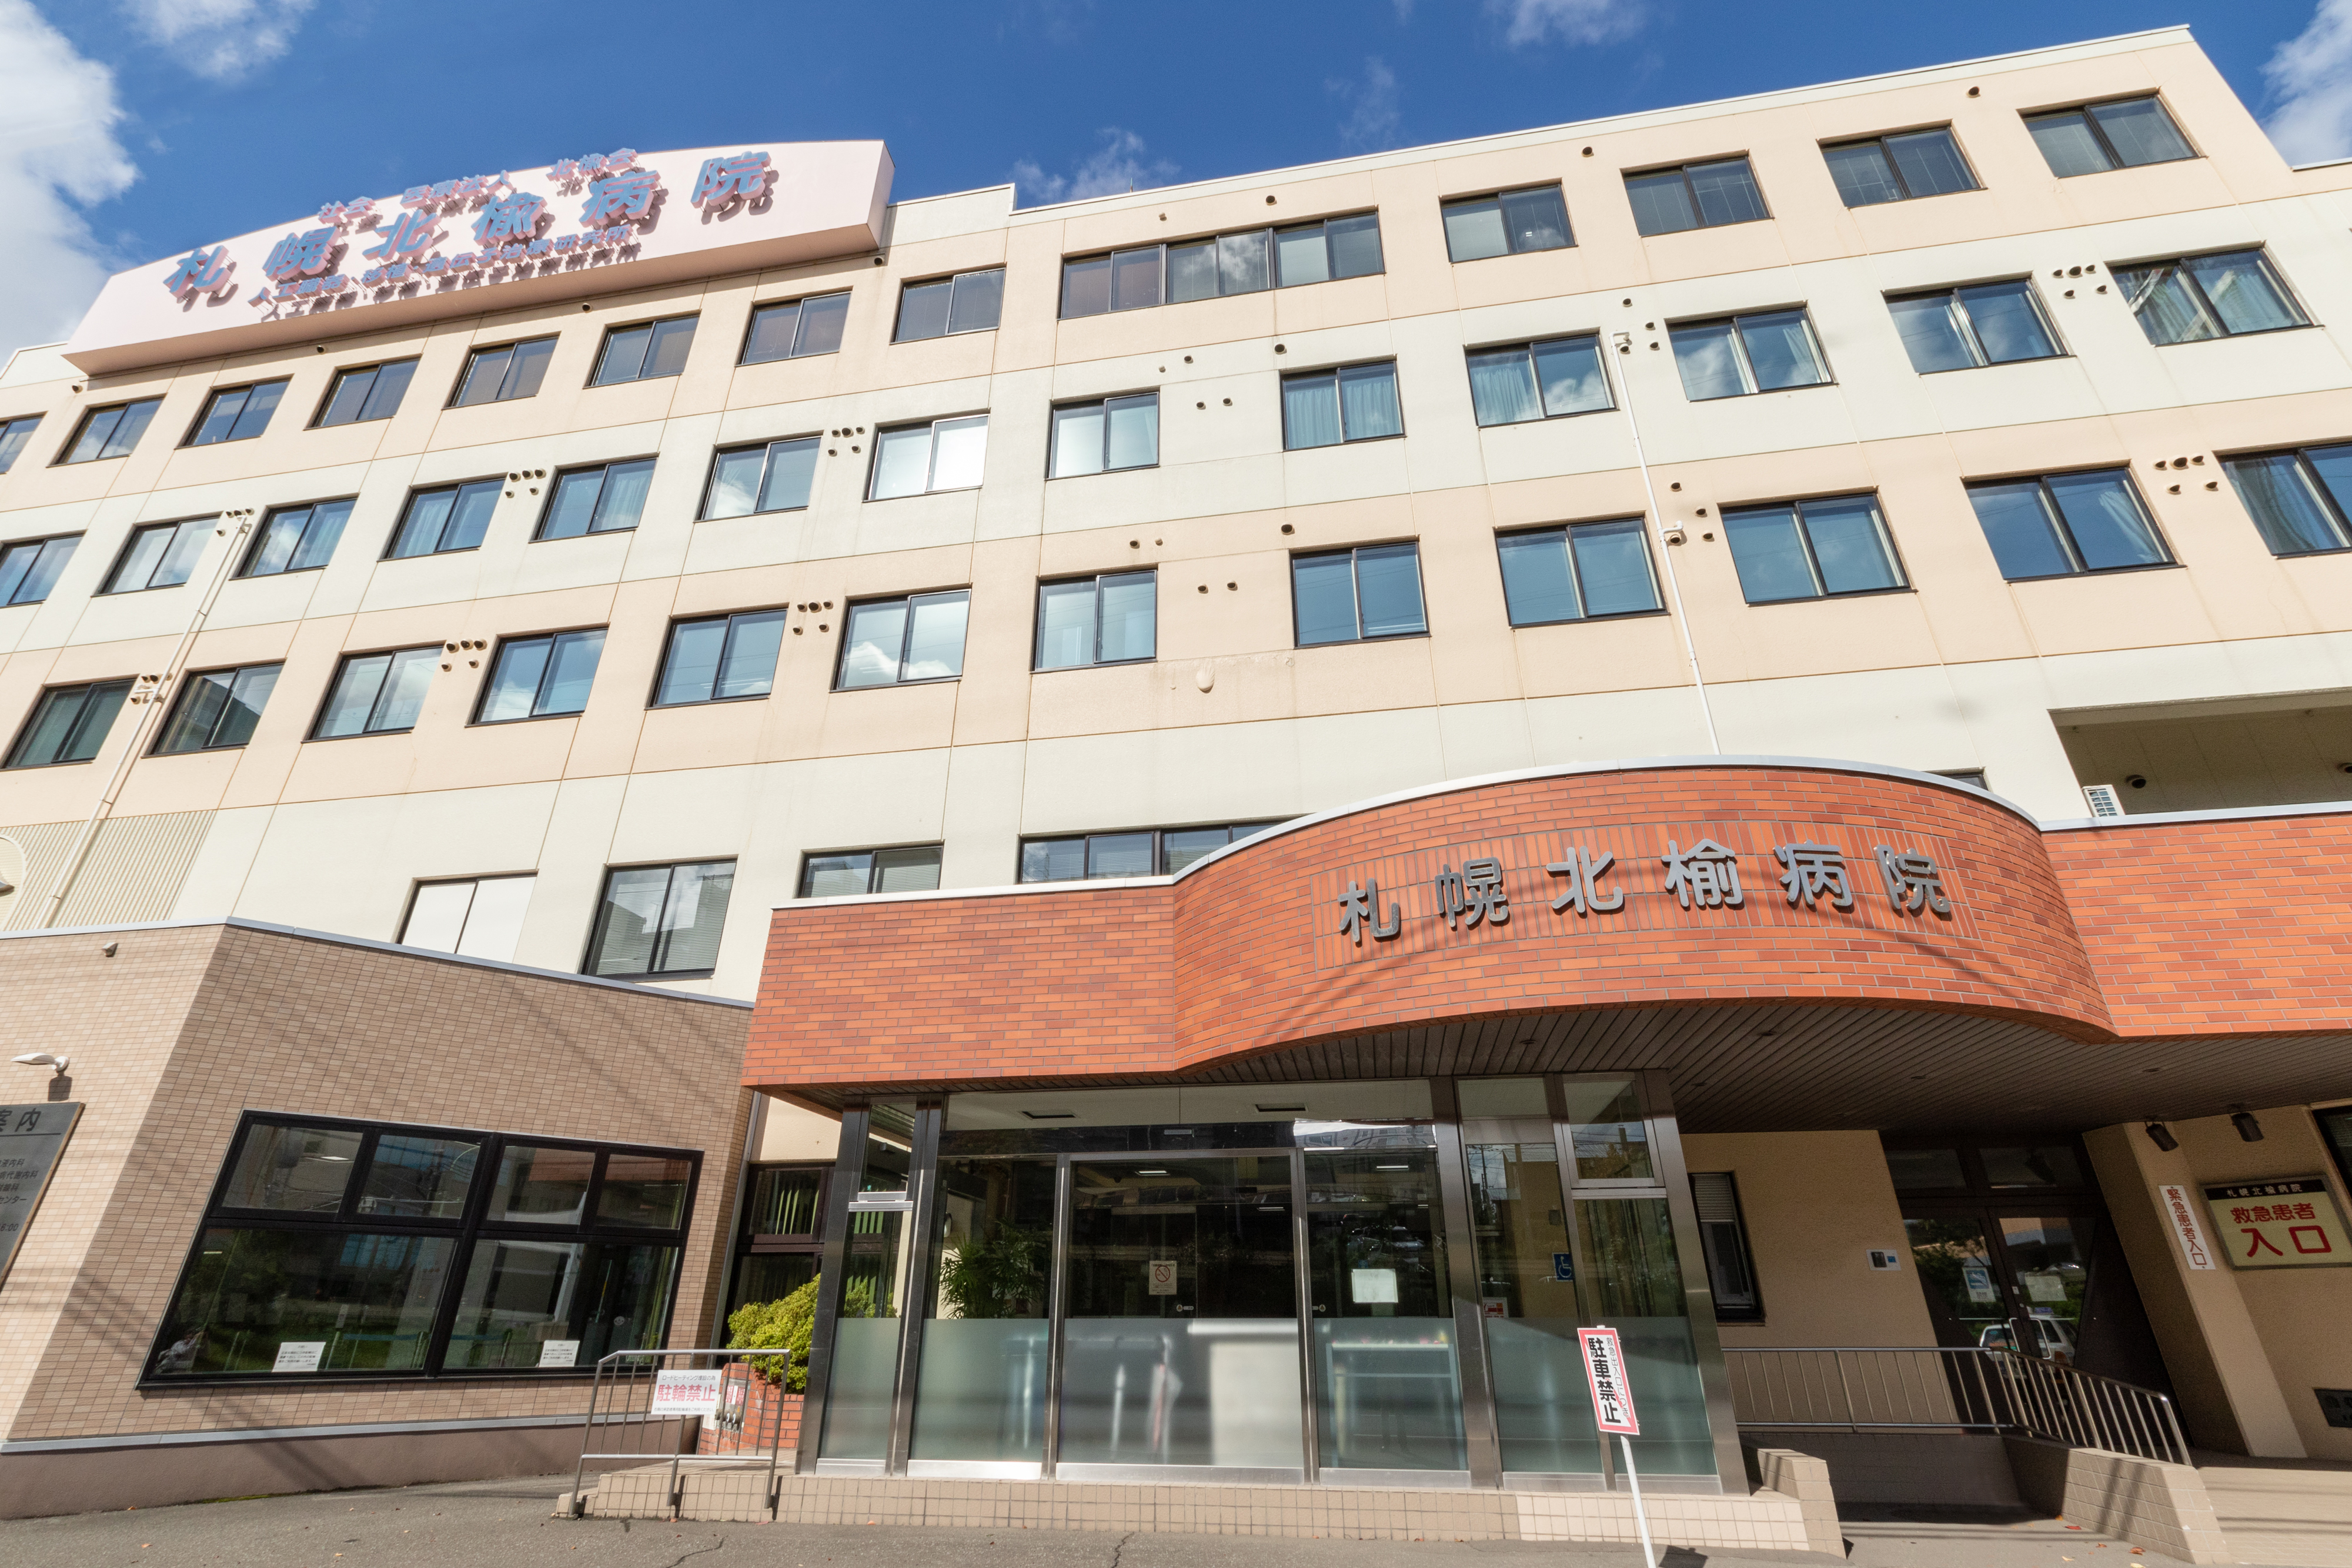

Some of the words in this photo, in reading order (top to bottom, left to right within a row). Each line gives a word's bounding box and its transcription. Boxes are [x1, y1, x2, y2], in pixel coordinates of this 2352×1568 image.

[163, 151, 771, 299] 札幌北楡病院
[318, 196, 376, 225] 社会
[400, 170, 512, 209] 医療法人
[1337, 838, 1950, 942] 札幌北楡病院
[0, 1158, 25, 1168] 液内科
[0, 1223, 19, 1232] 6:00
[2167, 1188, 2207, 1266] 緊急患者入口
[2230, 1203, 2316, 1224] 救急患者
[2241, 1225, 2332, 1258] 入口
[656, 1384, 716, 1402] 駐輪禁止
[1587, 1337, 1621, 1423] 駐車禁止
[1606, 1336, 1629, 1417] 救急出入口につき
